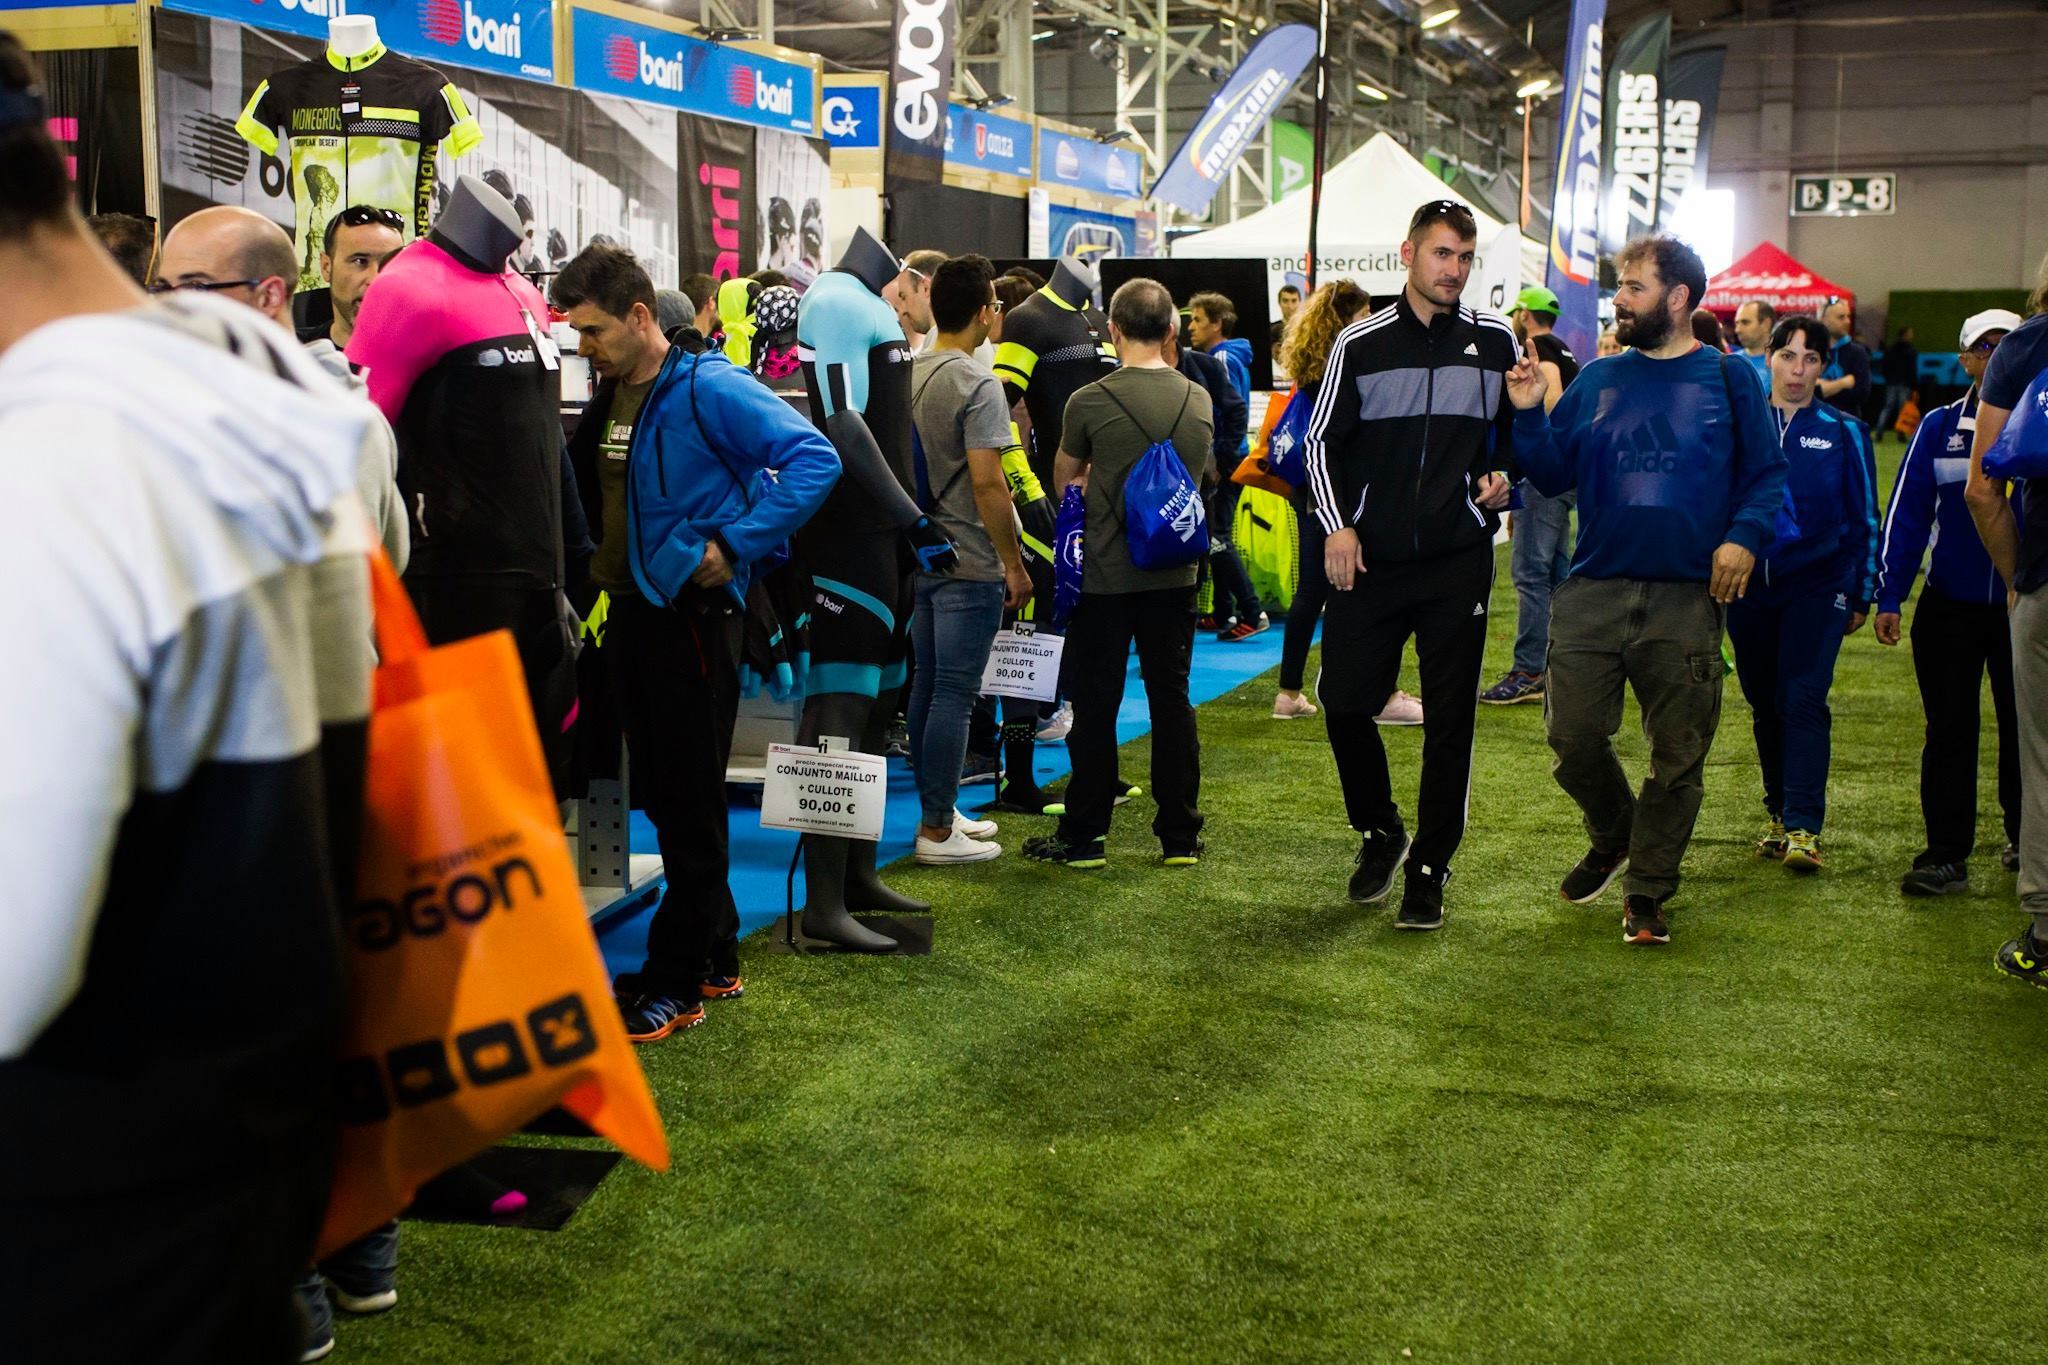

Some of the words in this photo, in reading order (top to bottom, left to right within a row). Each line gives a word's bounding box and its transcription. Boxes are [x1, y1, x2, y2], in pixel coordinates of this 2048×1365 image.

[465, 0, 521, 58] barri
[639, 41, 684, 92] barri
[755, 70, 793, 115] barri
[292, 107, 342, 131] MONEGROS
[1200, 68, 1282, 179] maxim
[319, 139, 338, 147] DESERT
[1827, 179, 1889, 211] P-8
[503, 344, 536, 364] barri
[822, 596, 845, 615] barri
[1021, 646, 1054, 658] MAILLOT
[1002, 657, 1034, 668] CULLOTE
[996, 668, 1024, 680] 90,00
[1028, 672, 1036, 681] €
[795, 759, 816, 767] precio
[817, 761, 844, 769] especial
[776, 764, 832, 779] CONJUNTO
[835, 770, 878, 784] MAILLOT
[807, 784, 853, 797] CULLOTE
[799, 798, 841, 814] 90,00
[846, 803, 856, 815] €
[810, 817, 837, 826] especial
